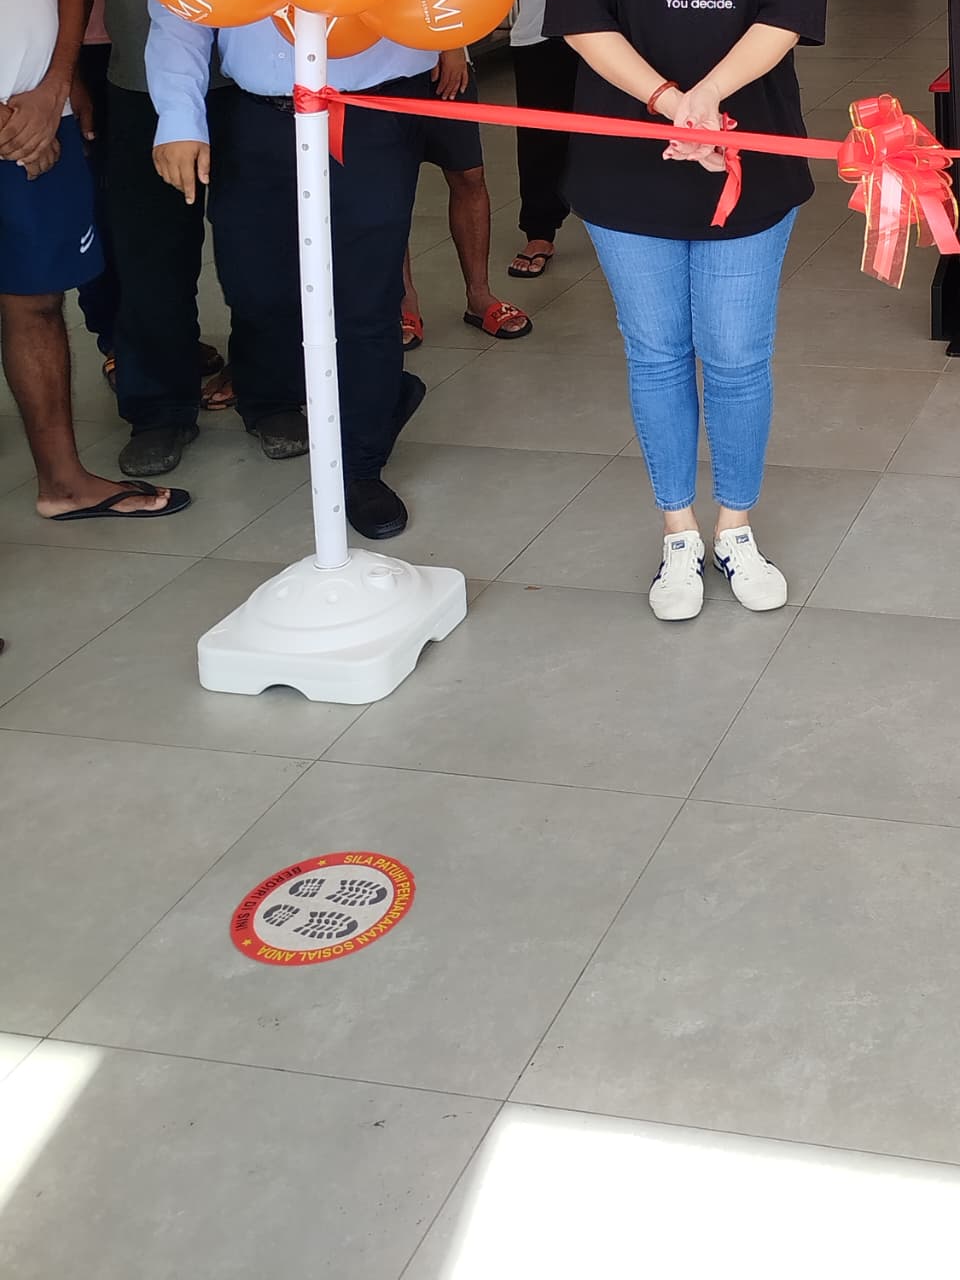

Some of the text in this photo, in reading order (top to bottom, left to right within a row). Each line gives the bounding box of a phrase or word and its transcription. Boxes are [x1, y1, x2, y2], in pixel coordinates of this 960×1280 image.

[235, 866, 302, 931] BERDIRI DI SINI
[257, 855, 411, 962] SILA PATUHI PENJARAKAN SOSIAL ANDA
